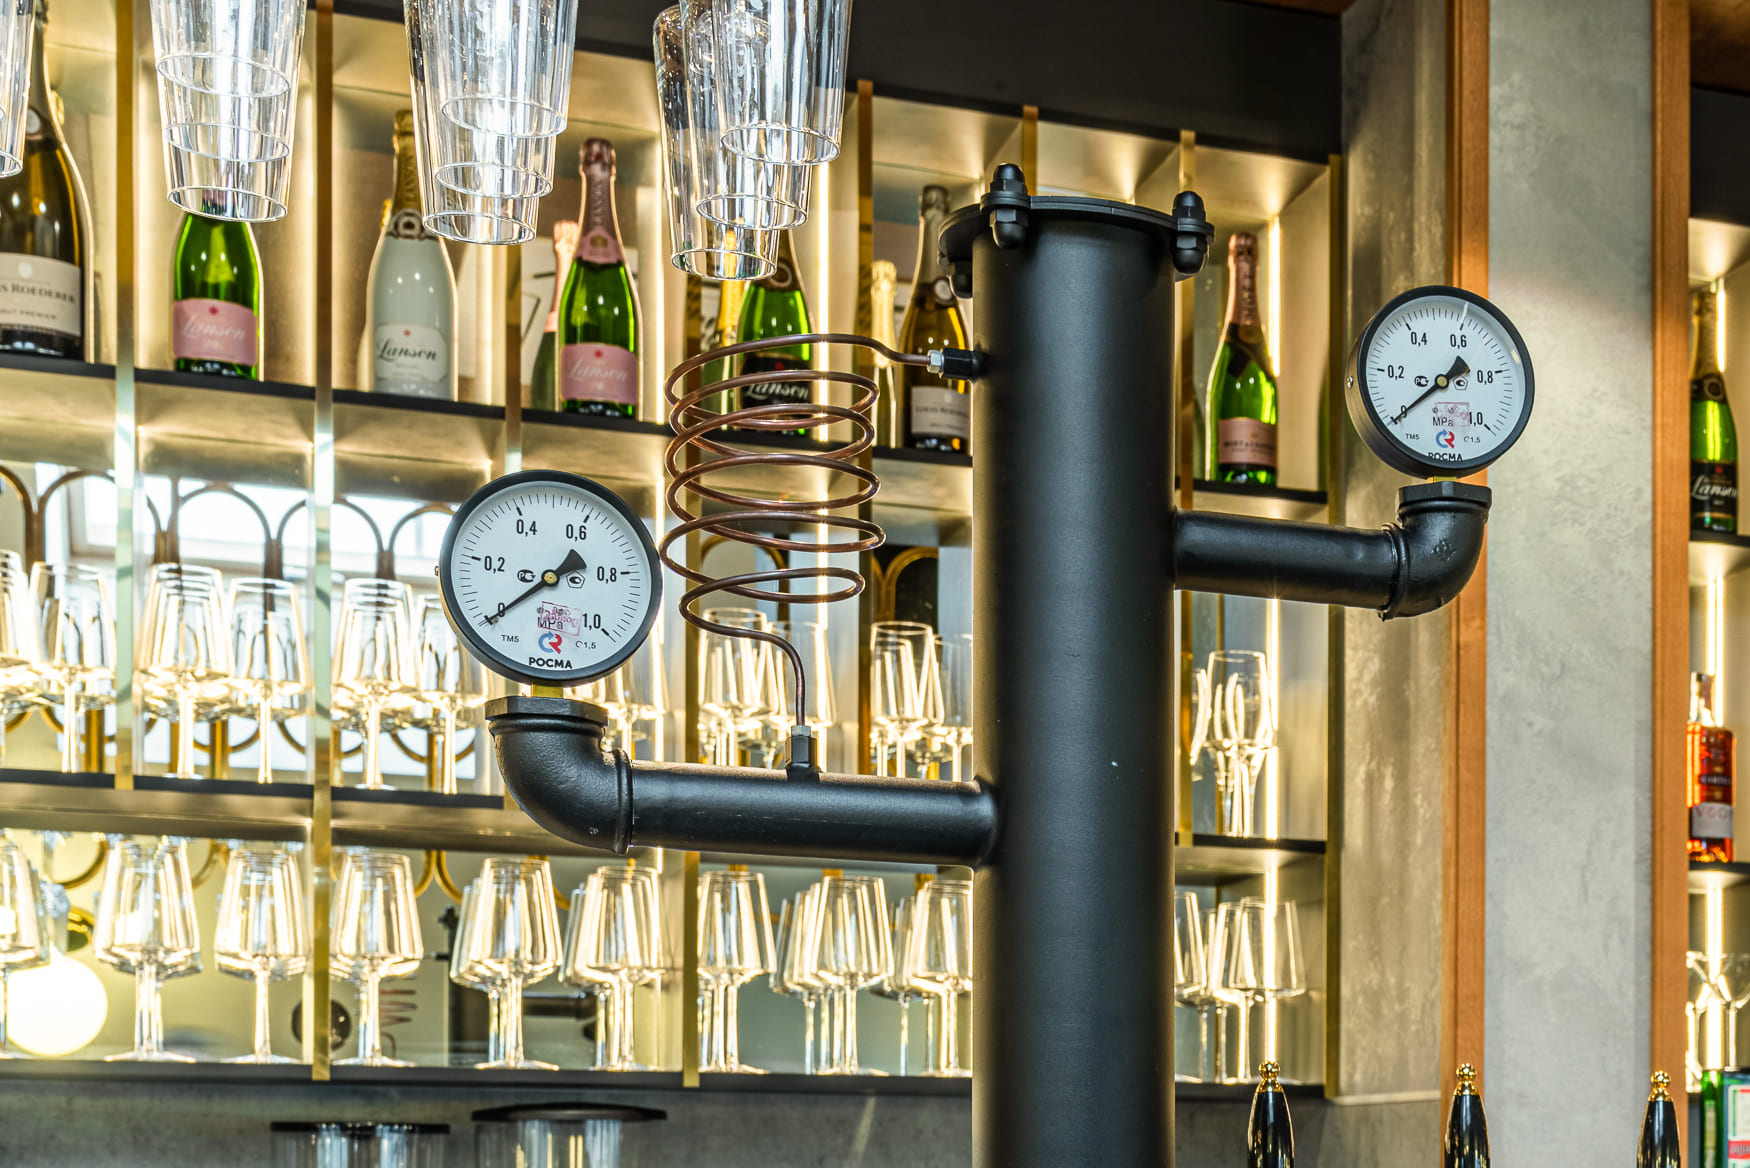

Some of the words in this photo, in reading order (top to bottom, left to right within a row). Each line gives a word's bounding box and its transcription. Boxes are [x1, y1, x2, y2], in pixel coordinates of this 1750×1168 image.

[182, 313, 246, 341] Lanson
[1410, 332, 1427, 347] 0,4
[1450, 334, 1467, 349] 0,6
[379, 337, 437, 363] Lanson
[570, 356, 628, 383] Lanson
[1387, 365, 1404, 380] 0,2
[1477, 370, 1493, 385] 0,8
[745, 381, 808, 400] Lanson
[1432, 416, 1454, 427] MPa
[1469, 412, 1483, 427] 1,0
[516, 519, 537, 537] 0,4
[566, 524, 587, 541] 0,6
[484, 556, 505, 574] 0,2
[597, 566, 617, 583] 0,8
[537, 616, 563, 630] MPa
[582, 613, 601, 631] 1,0
